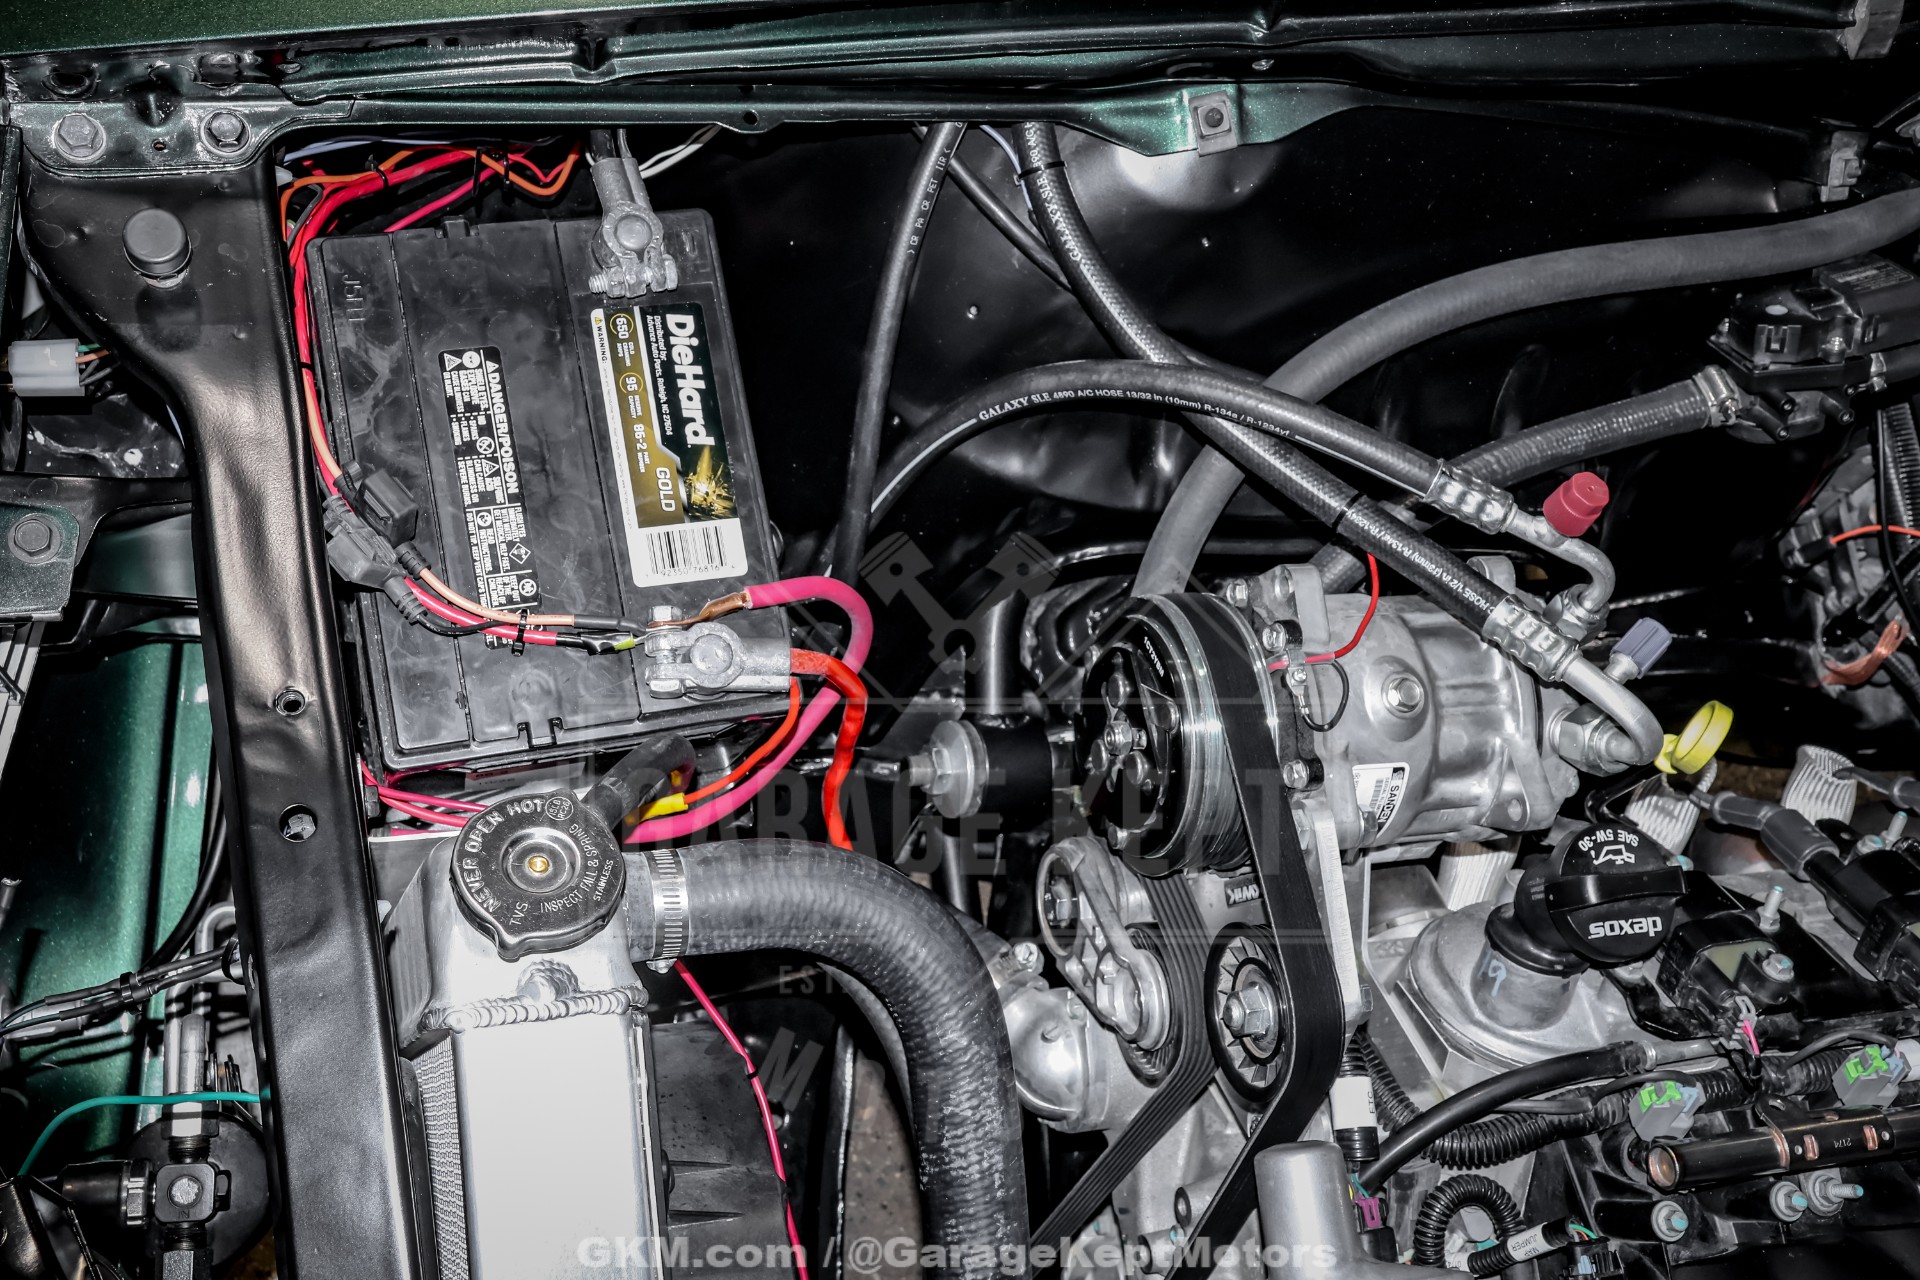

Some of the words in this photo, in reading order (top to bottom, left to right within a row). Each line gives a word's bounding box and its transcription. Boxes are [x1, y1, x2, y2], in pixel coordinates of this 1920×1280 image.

[1025, 131, 1039, 147] A/C
[1036, 176, 1053, 199] SLE
[909, 235, 920, 246] CR
[915, 217, 924, 228] PA
[920, 200, 931, 211] CR
[927, 178, 939, 193] PET
[935, 156, 948, 171] IIR
[1044, 201, 1082, 262] GALAXY
[615, 316, 629, 339] 650
[646, 314, 657, 342] Advance
[653, 315, 666, 350] Distributed
[596, 325, 607, 363] WARNING:
[622, 341, 631, 366] CRANKING
[650, 342, 659, 357] Auto
[658, 350, 667, 361] by:
[442, 371, 450, 380] OR
[450, 370, 459, 386] CAUSE
[652, 358, 662, 377] Parts,
[458, 369, 469, 391] GASES
[466, 369, 479, 405] EXPLOSIVE
[473, 367, 485, 391] SHIELD
[625, 376, 637, 392] 95
[452, 385, 464, 413] BLINDNESS
[462, 391, 470, 402] CAN
[477, 391, 488, 410] EYES.
[655, 377, 667, 403] Raleigh,
[627, 395, 636, 418] CAPACITY
[633, 394, 642, 416] RESERVE
[660, 403, 668, 413] NC
[978, 397, 1030, 422] GALAXY
[1031, 391, 1053, 405] SLE
[1053, 389, 1076, 399] 4890
[1077, 389, 1094, 398] A/C
[1095, 389, 1124, 398] HOSE
[1125, 390, 1152, 401] 13/32
[1165, 395, 1202, 410] (10mm)
[1204, 403, 1239, 420] R-134a
[1246, 415, 1291, 438] R-1234yf
[468, 419, 479, 440] SPARKS
[476, 414, 486, 425] NO
[451, 421, 462, 445] SMOKING
[459, 420, 470, 441] FLAMES
[486, 371, 519, 494] DANGER/POISON
[633, 423, 647, 450] 86-2
[457, 460, 467, 484] SEVERE
[473, 458, 482, 472] CAN
[636, 451, 645, 472] NUMBER
[465, 459, 477, 493] BLINDNESS
[471, 493, 479, 503] OR
[475, 472, 485, 492] CAUSE
[484, 476, 494, 491] ACID
[491, 475, 504, 503] SULFURIC
[655, 466, 676, 512] GOLD
[460, 484, 472, 507] BURNS.
[464, 512, 473, 521] DO
[492, 508, 501, 519] GET
[500, 508, 509, 523] WITH
[514, 506, 524, 525] FLUSH
[1344, 507, 1379, 536] R-1234y
[466, 521, 475, 534] NOT
[485, 527, 495, 544] READ
[494, 518, 505, 543] MEDICAL
[506, 507, 520, 543] IMMEDIATELY
[517, 524, 526, 537] EYES
[470, 545, 480, 560] KEEP
[478, 528, 492, 573] INSTRUCTIONS.
[498, 542, 507, 556] HELP
[1381, 532, 1412, 558] R-134a
[473, 560, 483, 576] VENT
[500, 556, 510, 572] FAST.
[693, 563, 719, 573] 76816
[1410, 549, 1443, 578] (13mm)
[475, 576, 486, 593] CAPS
[494, 576, 503, 594] REACH
[501, 576, 509, 585] OF
[503, 585, 511, 596] THE
[508, 575, 518, 590] KEEP
[1448, 577, 1465, 592] 1/2
[479, 593, 487, 608] TIGH
[487, 577, 499, 607] CHILDREN.
[497, 594, 505, 604] OF
[511, 590, 520, 602] OUT
[1462, 587, 1489, 610] HOSE
[506, 799, 546, 817] HOT
[1378, 785, 1400, 823] SANDEN
[464, 810, 505, 853] OPEN
[569, 823, 599, 857] SPRING
[1578, 830, 1614, 852] 5W-30
[1617, 829, 1640, 847] SAE
[587, 859, 599, 867] &
[462, 857, 502, 912] NEVER
[580, 870, 598, 892] FALL
[592, 859, 614, 902] STAINLESS
[540, 889, 584, 913] INSPECT
[1588, 917, 1663, 940] dexos
[1833, 1137, 1852, 1149] 2174
[1511, 1234, 1538, 1252] JUMPER
[1524, 1246, 1540, 1257] MAP
